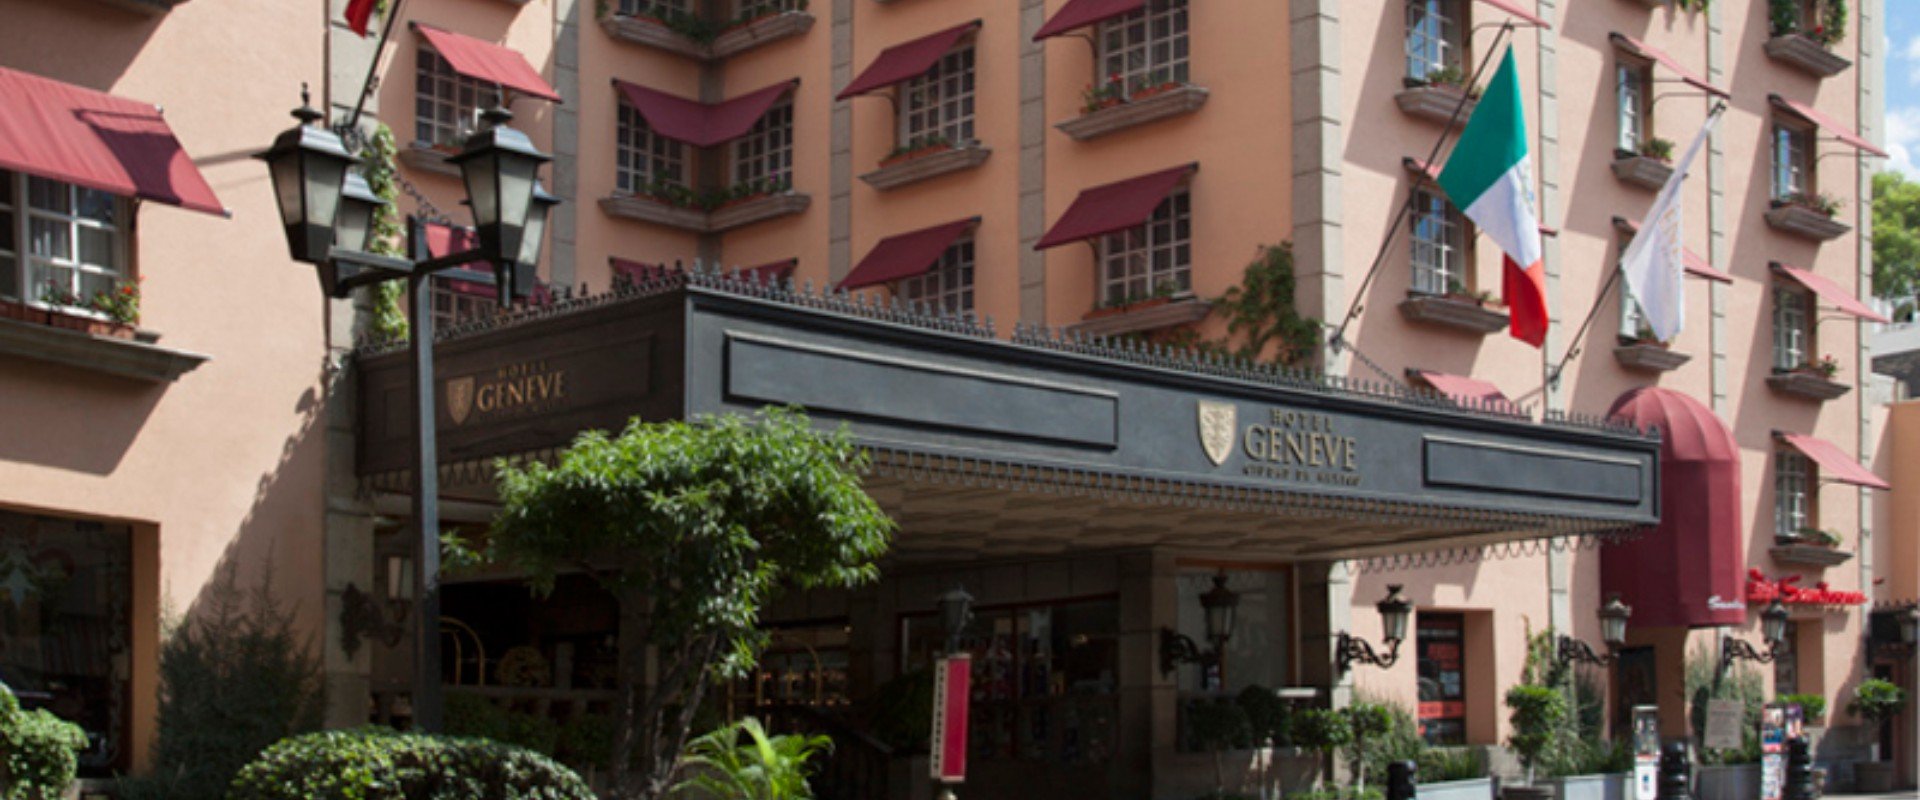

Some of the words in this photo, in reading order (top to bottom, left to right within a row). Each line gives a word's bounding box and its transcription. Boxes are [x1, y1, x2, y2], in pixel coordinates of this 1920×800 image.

[477, 371, 565, 412] GENEVE
[1269, 408, 1333, 433] HOTEL
[1243, 423, 1357, 471] GENEVE
